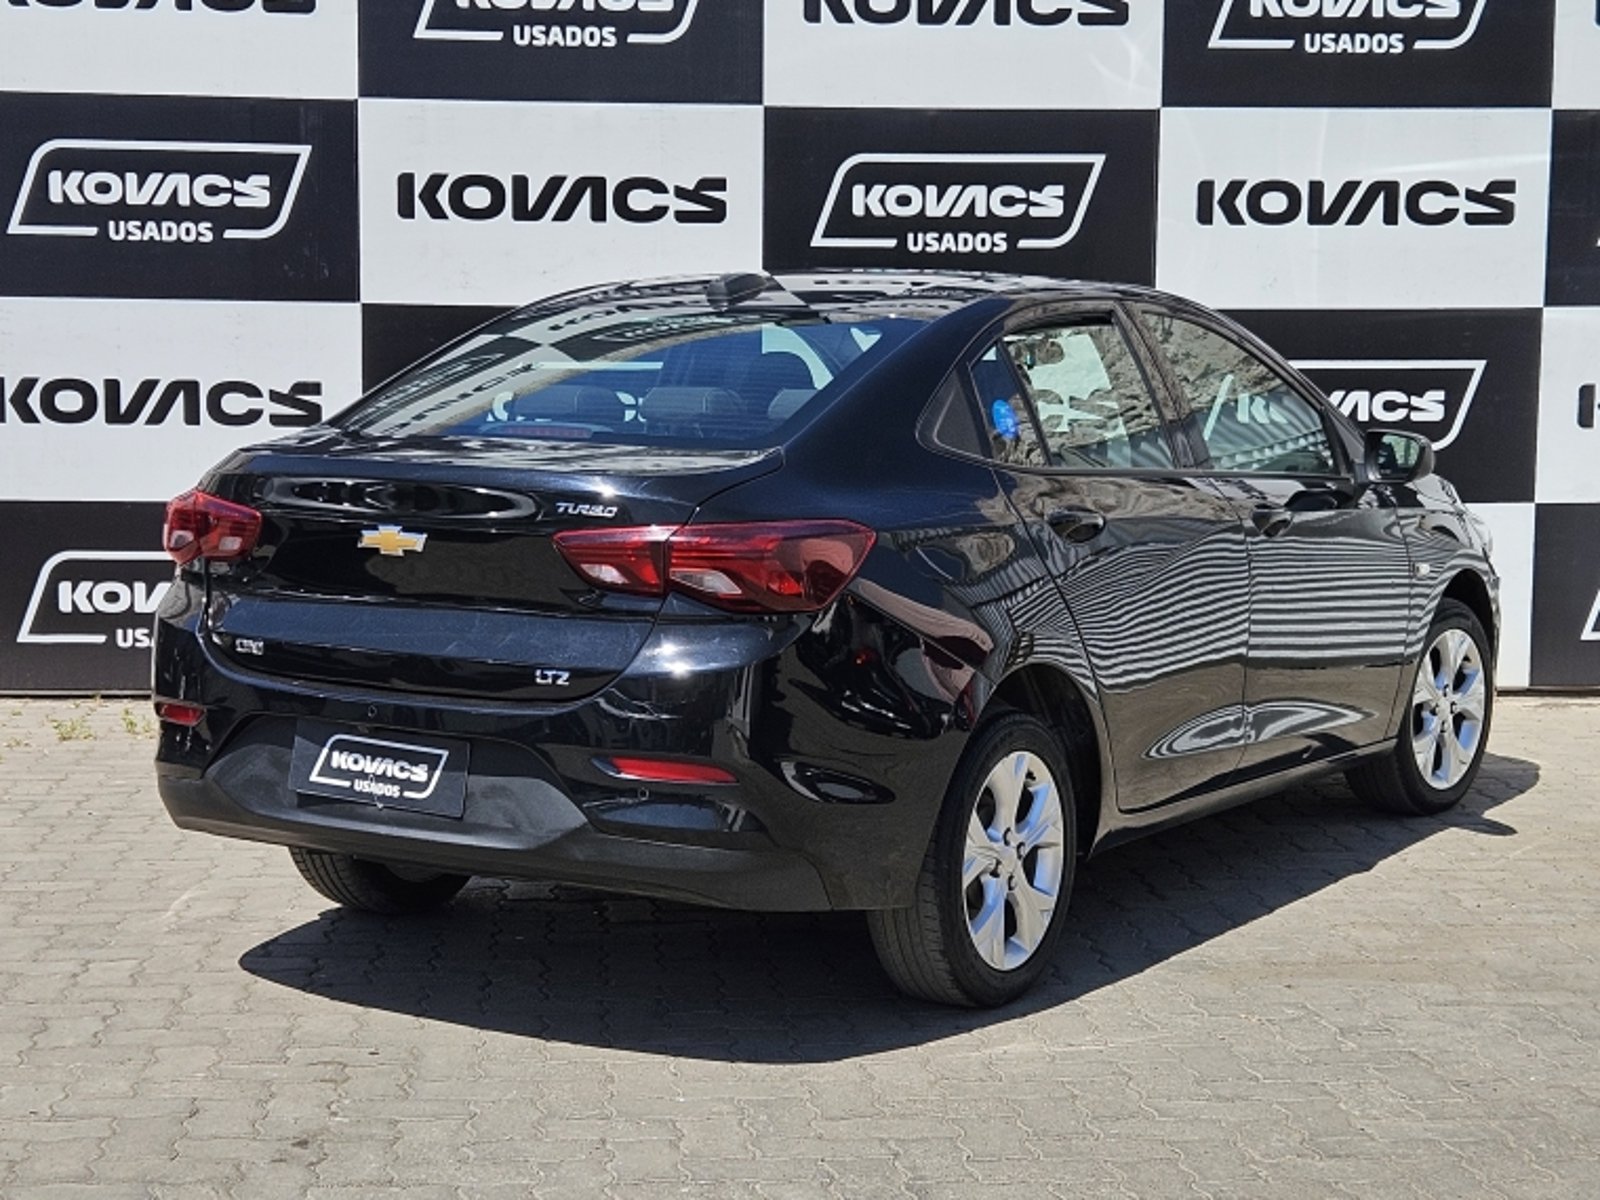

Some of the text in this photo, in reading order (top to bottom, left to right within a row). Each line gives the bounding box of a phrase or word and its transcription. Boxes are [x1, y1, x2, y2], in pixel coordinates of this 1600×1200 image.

[513, 25, 617, 47] USADOS
[1304, 33, 1404, 53] USADOS
[48, 170, 270, 208] KOVACS
[397, 172, 727, 224] KOVACS
[852, 184, 1064, 218] KOVACS
[1196, 179, 1516, 226] KOVACS
[108, 220, 213, 243] USADOS
[907, 232, 1007, 253] USADOS
[0, 377, 323, 427] KOVACS
[555, 502, 618, 518] TURBO
[58, 580, 174, 613] KOV
[535, 669, 570, 686] LTZ
[330, 751, 429, 782] KOVACS
[353, 778, 401, 798] USADOS
